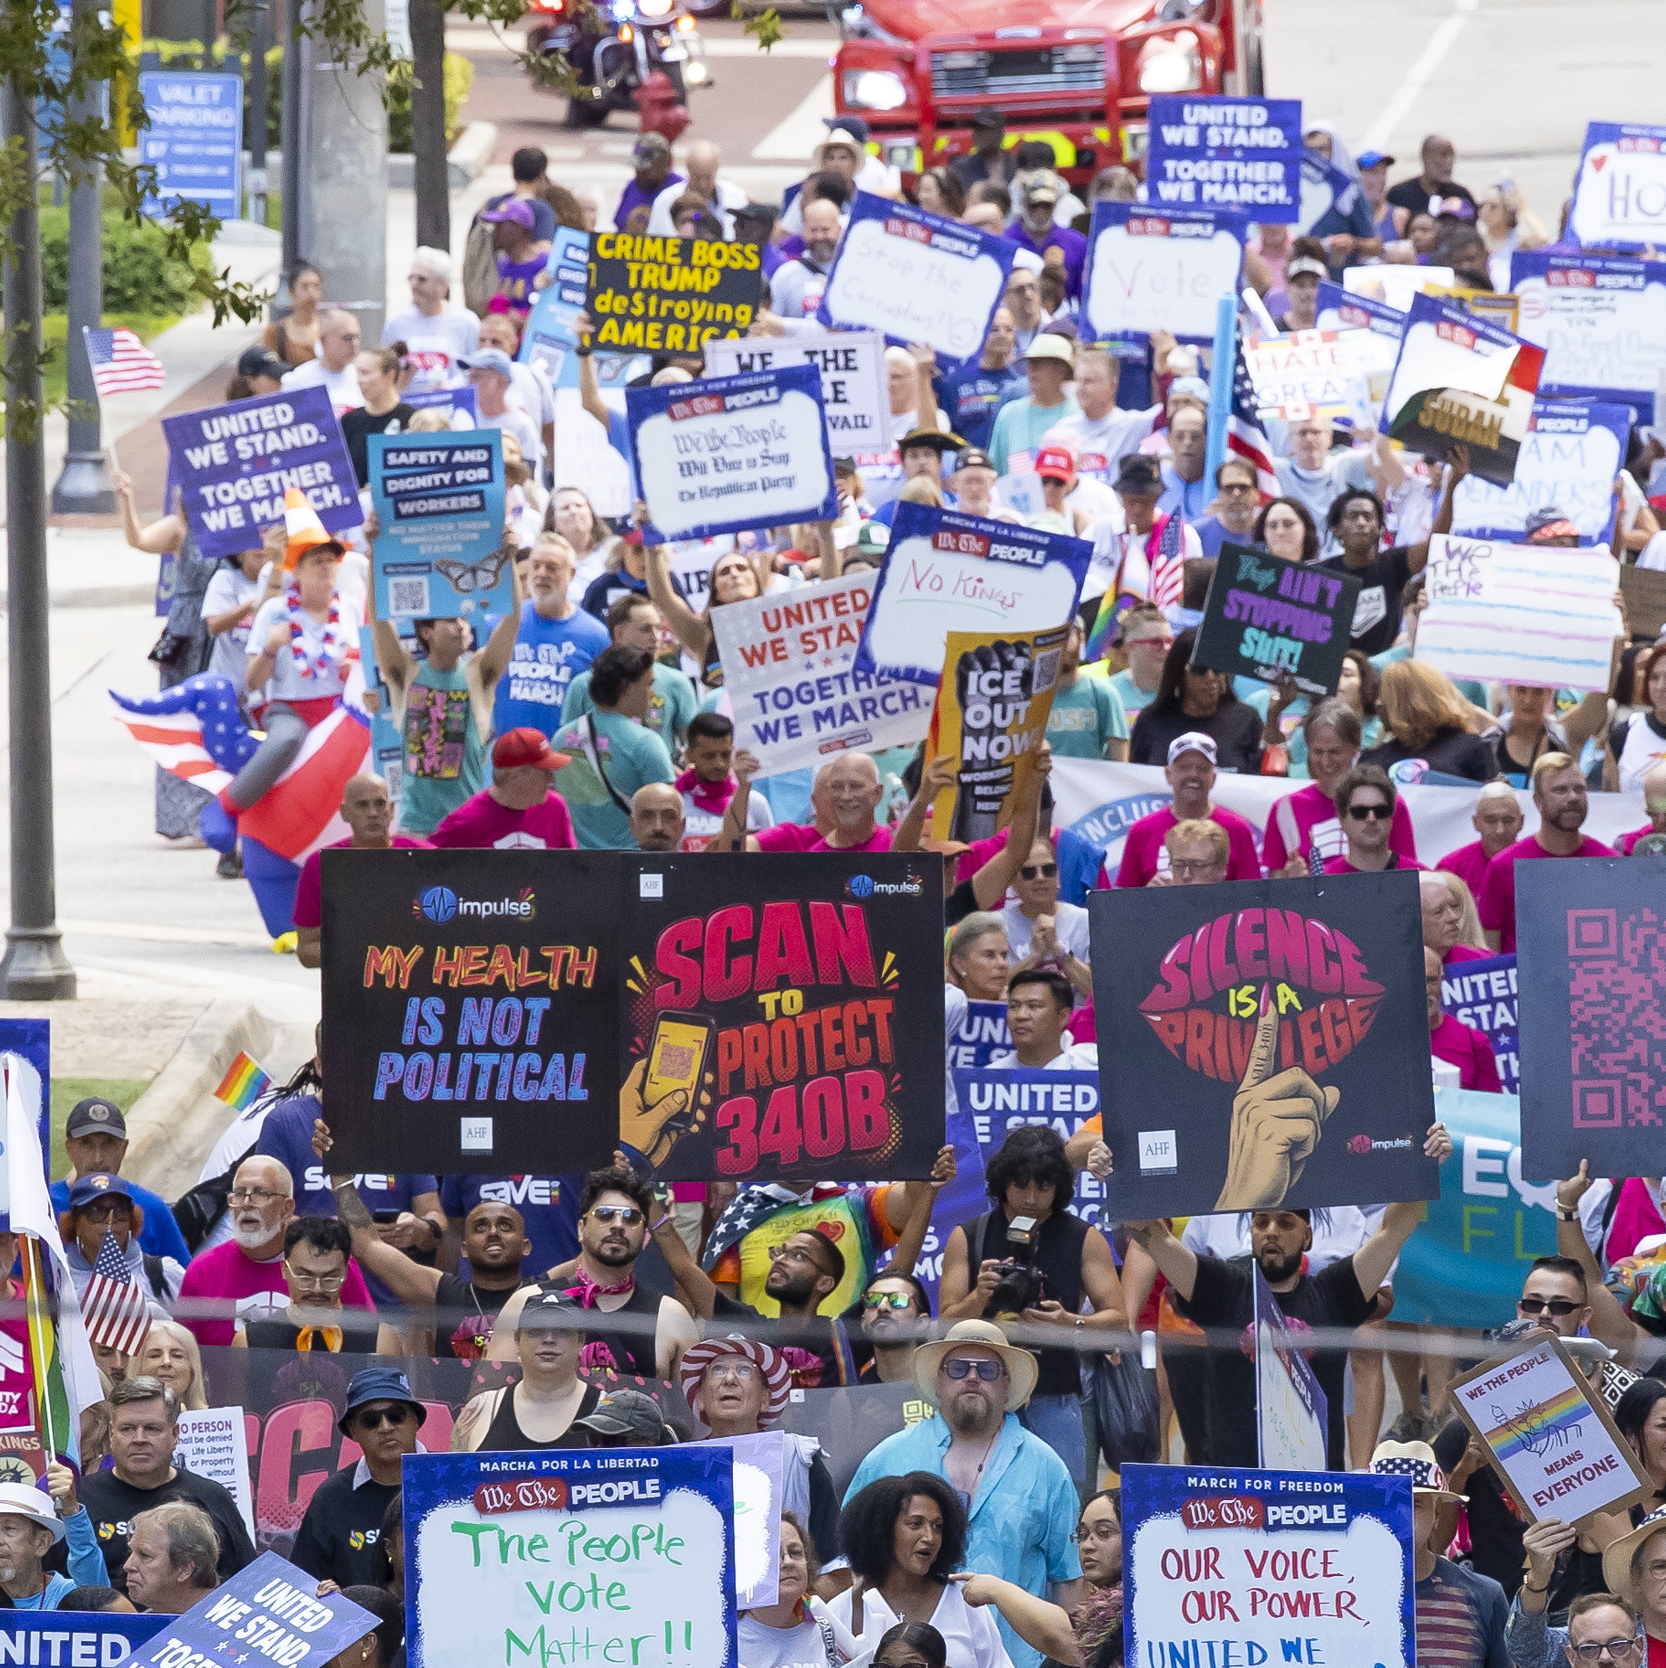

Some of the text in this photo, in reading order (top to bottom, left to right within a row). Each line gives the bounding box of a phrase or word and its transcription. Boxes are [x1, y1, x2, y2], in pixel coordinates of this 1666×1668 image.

[1183, 104, 1267, 126] UNITED
[1162, 127, 1288, 148] WE STAND.
[1164, 159, 1285, 182] TOGETHER
[1158, 182, 1292, 204] WE MARCH.
[597, 233, 760, 270] CRIME BOSS
[626, 262, 721, 293] TRUMP
[200, 403, 295, 442] UNITED
[185, 429, 328, 470] WE STAND.
[386, 449, 488, 466] SAFETY AND
[200, 462, 333, 507] TOGETHER
[387, 467, 489, 492] DIGNITY FOR
[399, 496, 481, 515] WORKERS
[1223, 589, 1333, 643] STOPPING
[967, 669, 1022, 697] ICE
[964, 701, 1032, 729] OUT
[962, 729, 1034, 762] NOW
[873, 879, 921, 896] impulse
[458, 895, 532, 920] impulse
[363, 945, 598, 991] MY HEALTH
[653, 900, 882, 1010] SCAN
[1138, 908, 1385, 1011] SILENCE
[758, 988, 804, 1020] TO
[1229, 983, 1302, 1018] IS A
[401, 997, 551, 1046] IS NOT
[717, 997, 895, 1095] PROTECT
[373, 1052, 590, 1102] POLITICAL
[714, 1070, 893, 1175] 340B
[1145, 1141, 1170, 1157] AHF
[1371, 1137, 1412, 1151] impulse
[1466, 1353, 1550, 1400] WE THE PEOPLE
[480, 1458, 659, 1472] MARCHA POR LA LIBERTAD
[1543, 1450, 1584, 1476] MEANS
[1533, 1454, 1619, 1508] EVERYONE
[451, 1520, 551, 1567] The
[1161, 1547, 1356, 1586] OUR VOICE,
[1181, 1589, 1371, 1629] OUR POWER,
[1280, 1637, 1324, 1666] WE
